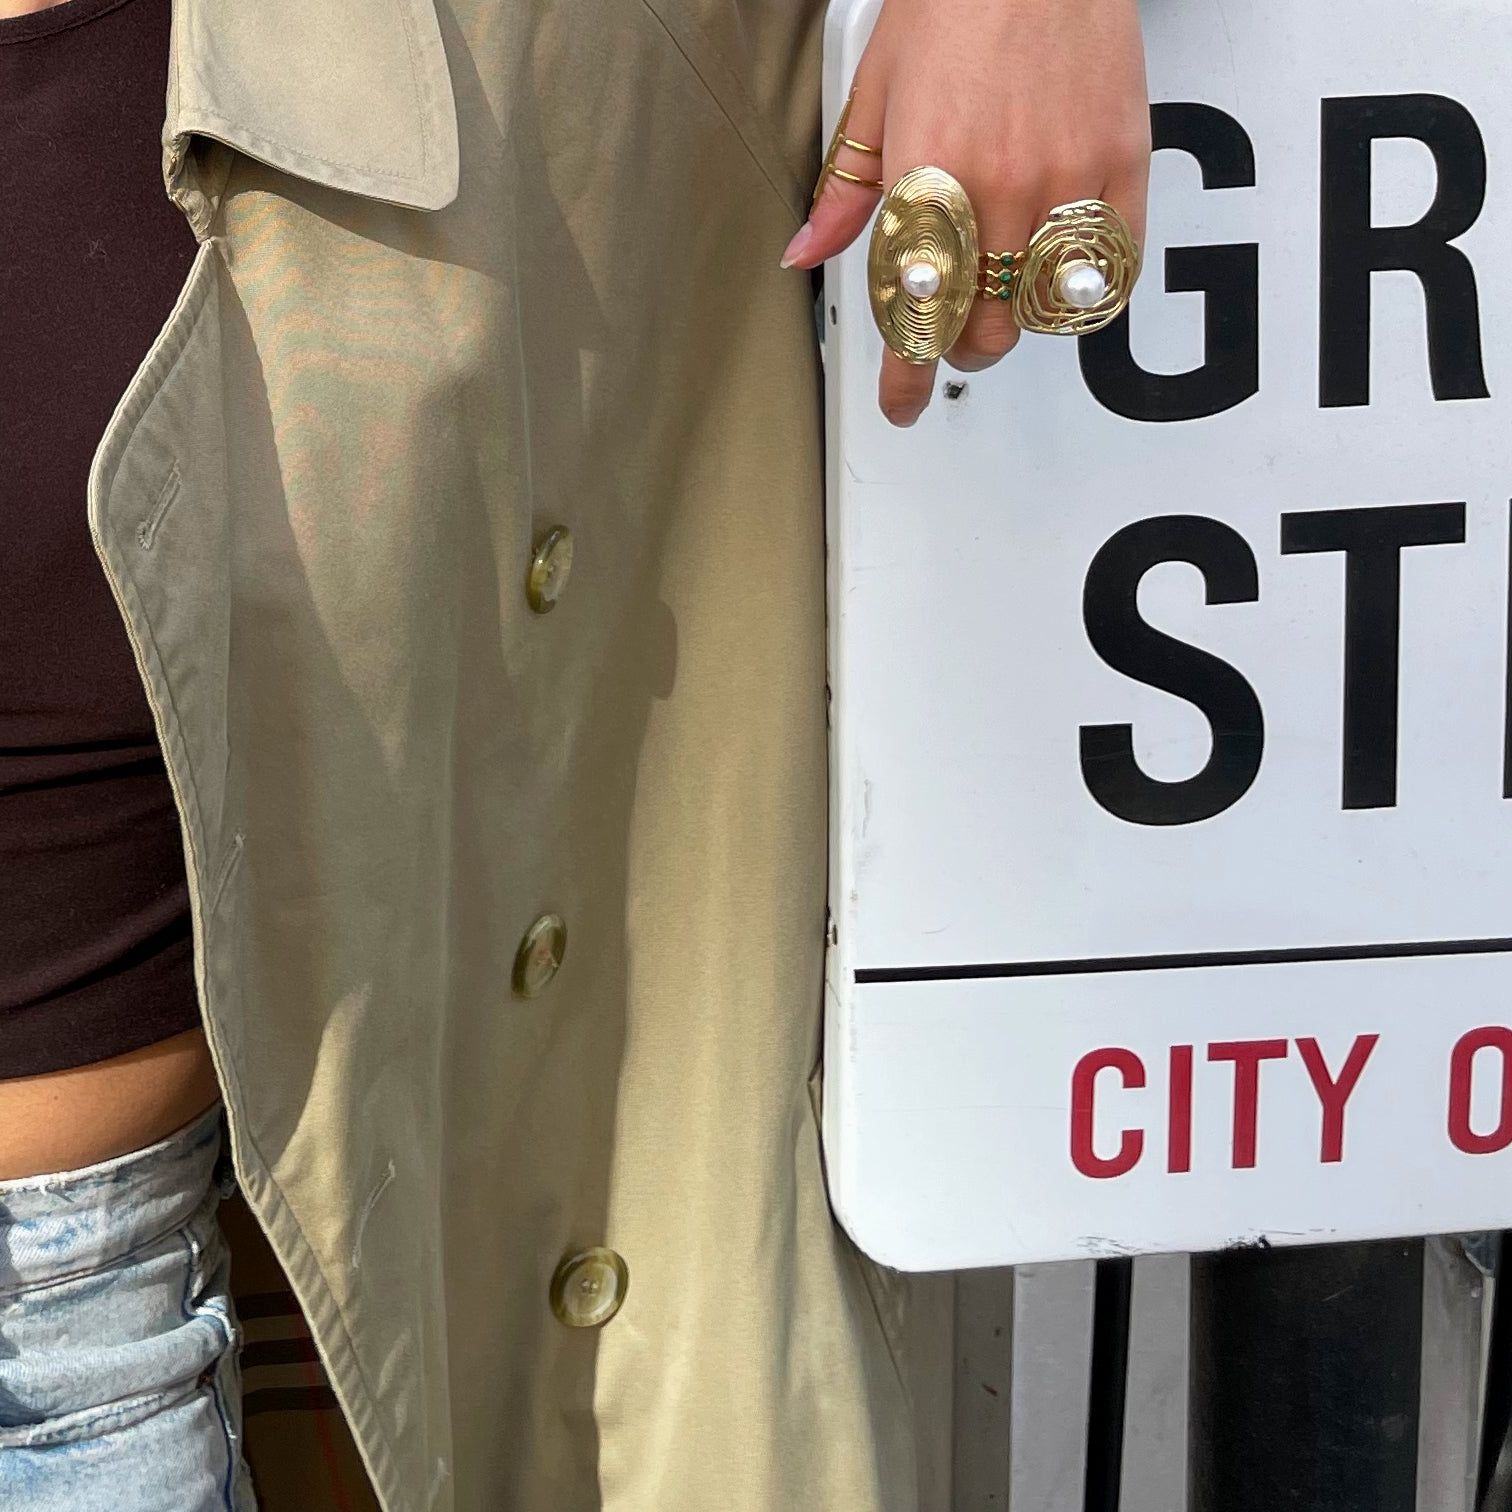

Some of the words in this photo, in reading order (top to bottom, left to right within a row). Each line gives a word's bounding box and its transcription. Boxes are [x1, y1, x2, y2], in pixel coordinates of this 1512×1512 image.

[1077, 93, 1491, 423] GR
[1078, 499, 1512, 827] ST
[1070, 1034, 1380, 1179] CITY
